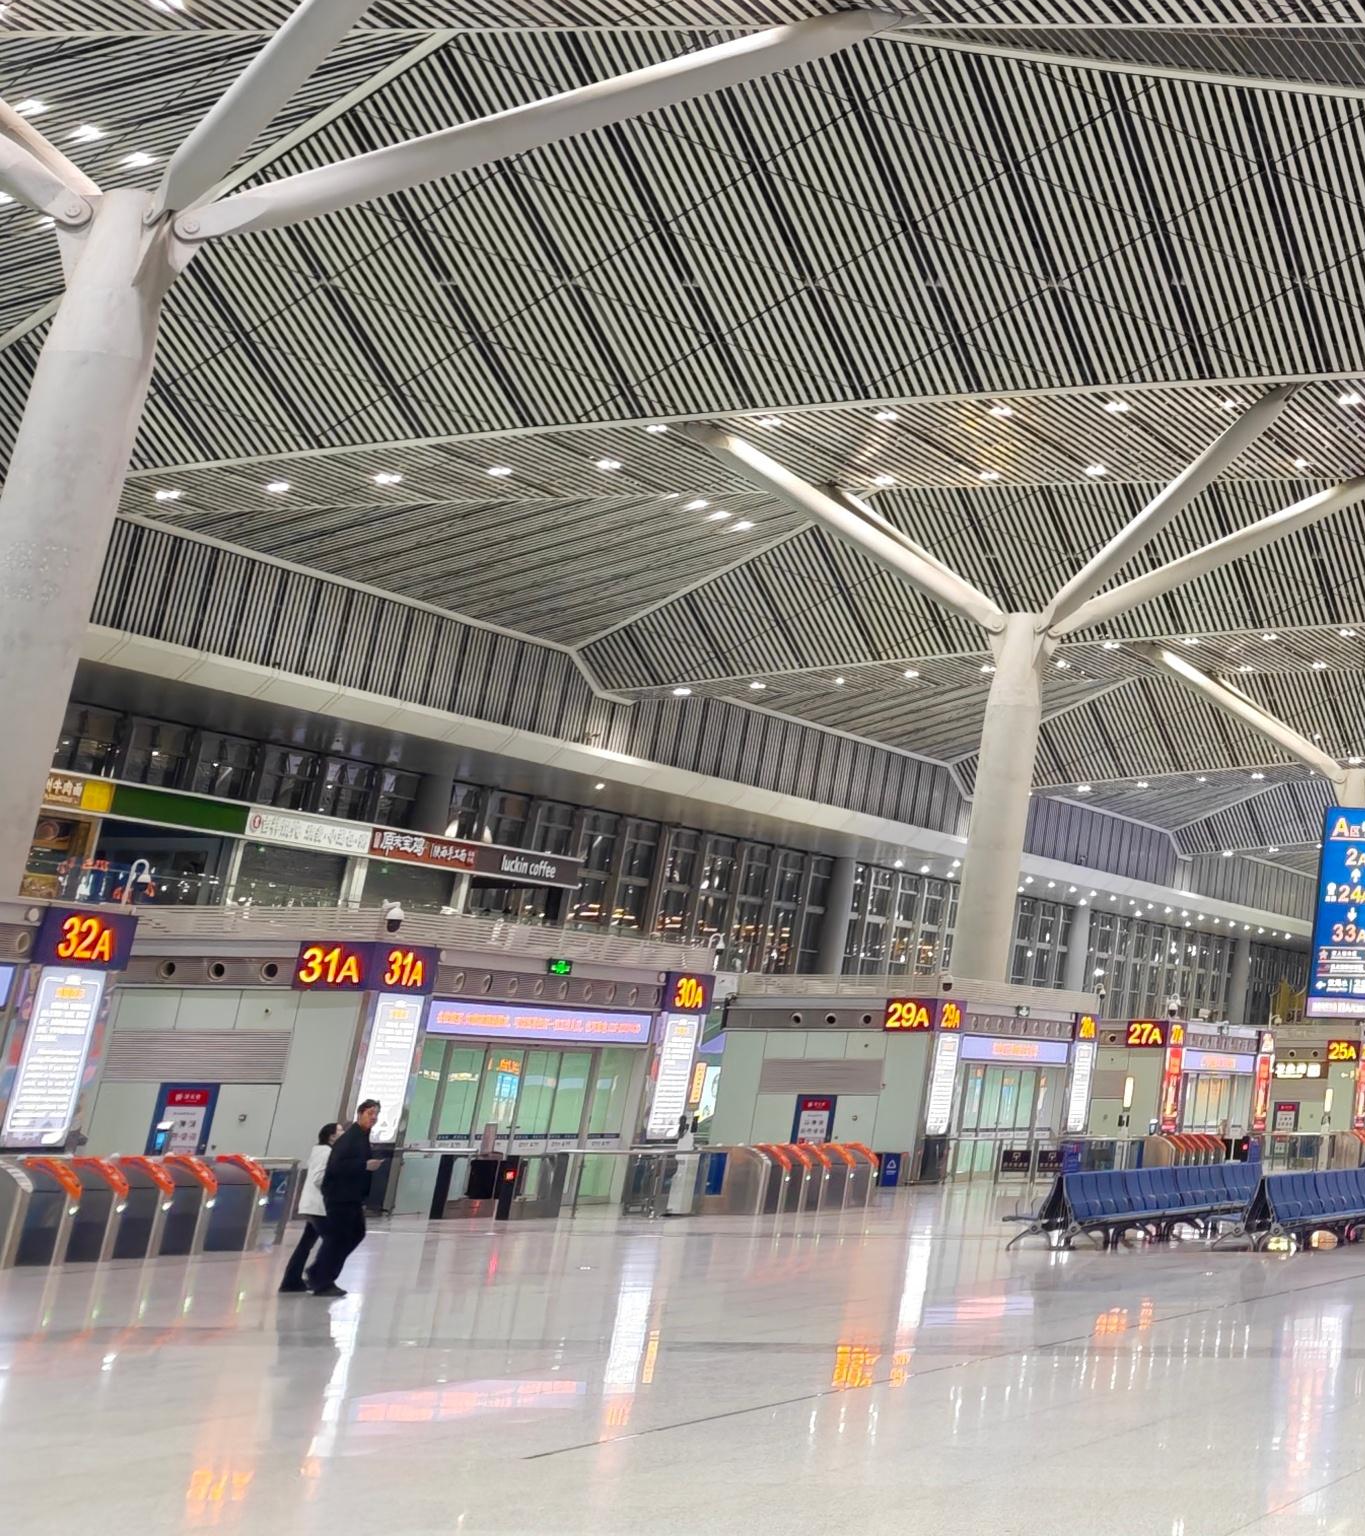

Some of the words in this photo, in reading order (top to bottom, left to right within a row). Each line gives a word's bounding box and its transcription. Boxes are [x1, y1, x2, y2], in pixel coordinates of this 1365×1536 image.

[501, 855, 527, 874] luckin
[529, 860, 556, 878] coffee
[57, 915, 111, 962] 32A
[300, 946, 360, 984] 31A
[384, 950, 423, 988] 31A
[674, 977, 703, 1009] 30A
[886, 1002, 930, 1029] 29A
[941, 1004, 960, 1029] 29A
[1127, 1023, 1163, 1046] 27A
[1328, 1042, 1357, 1061] 25A
